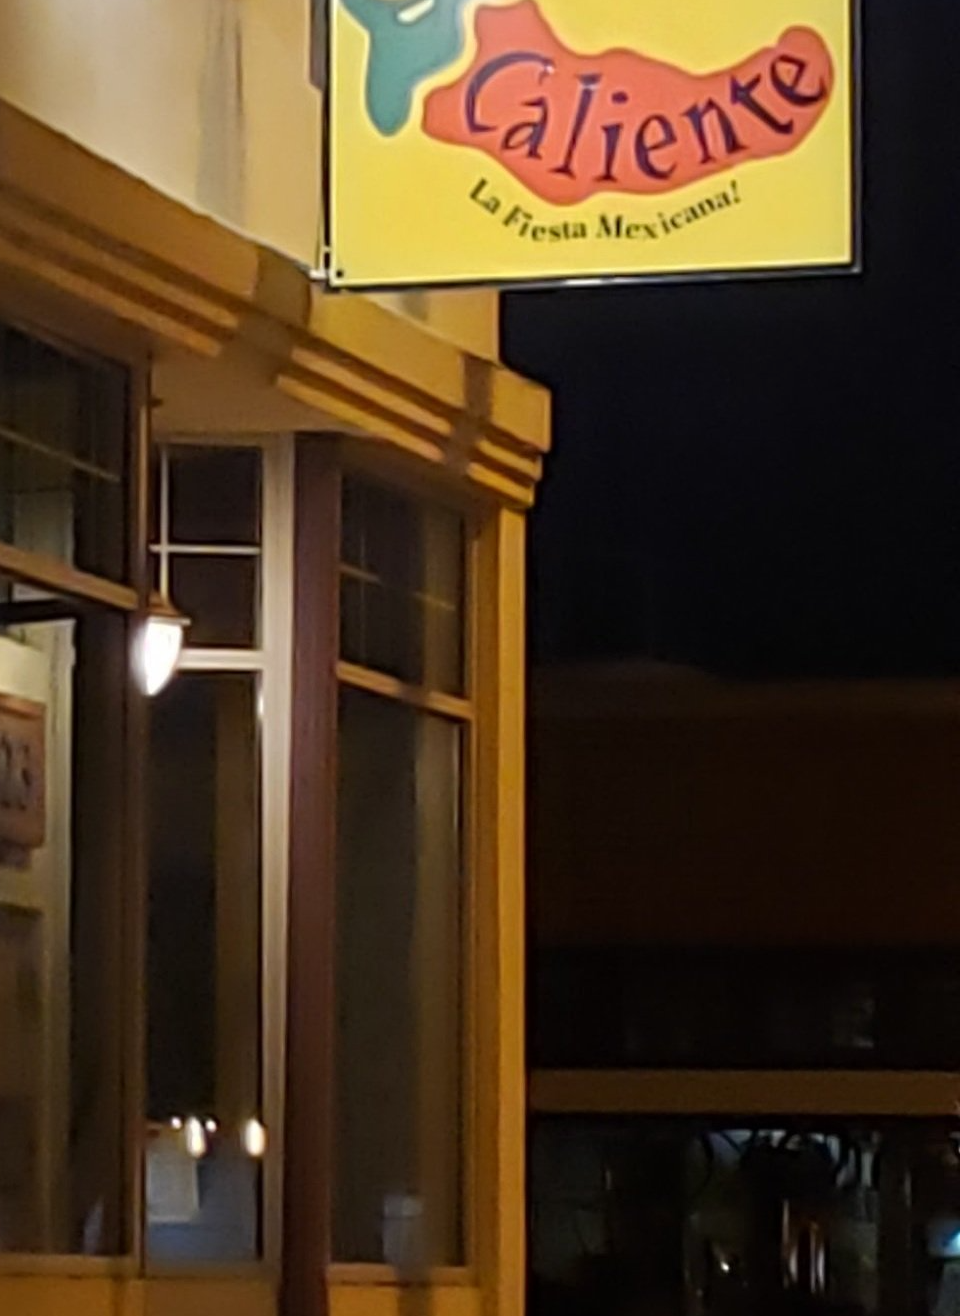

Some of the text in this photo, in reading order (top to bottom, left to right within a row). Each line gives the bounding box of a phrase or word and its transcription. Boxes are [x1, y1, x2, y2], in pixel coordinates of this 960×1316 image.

[466, 52, 827, 181] Caliente
[469, 178, 742, 242] La Fiesta Mexicana!
